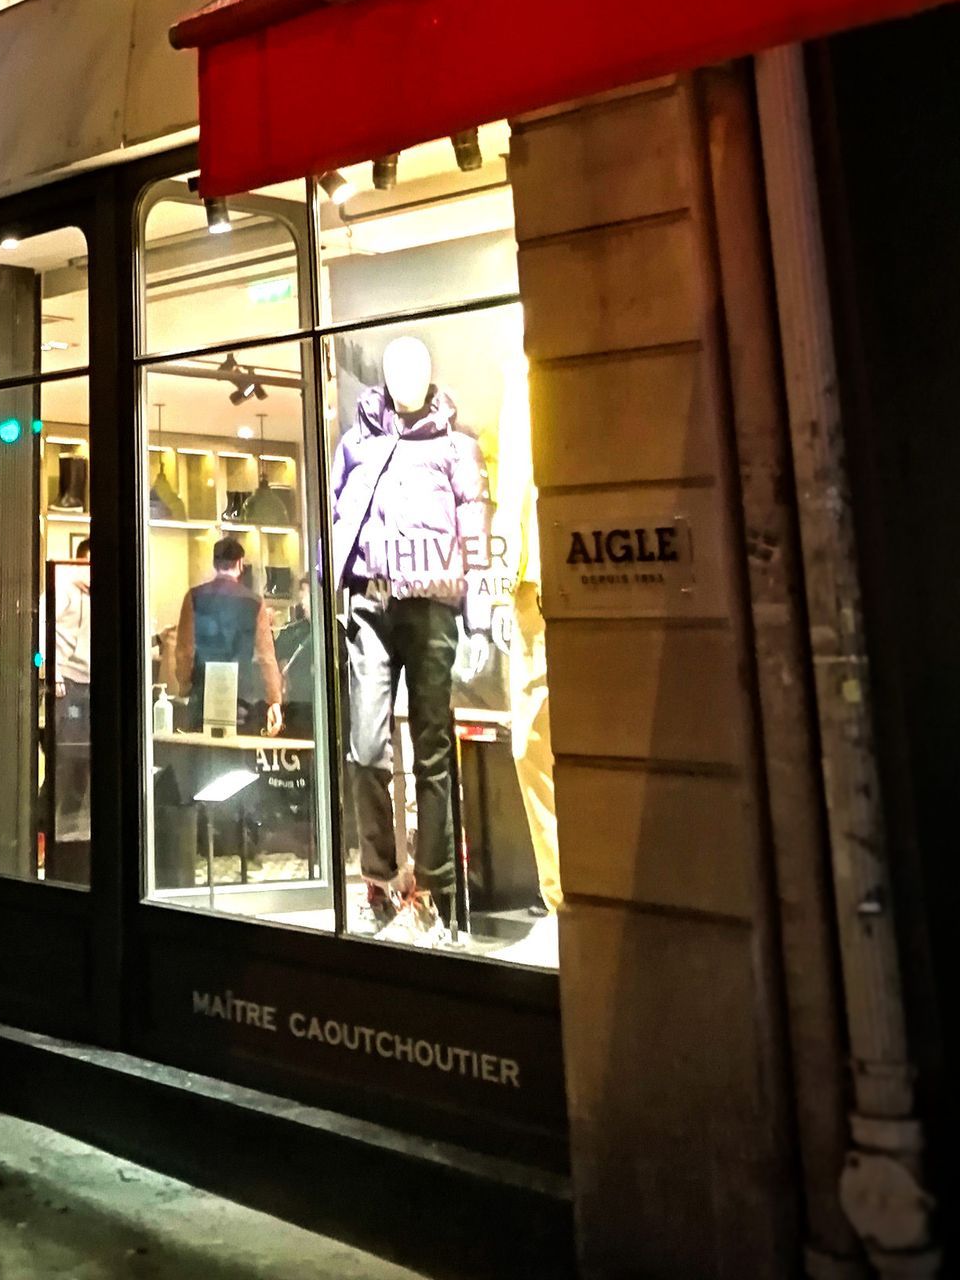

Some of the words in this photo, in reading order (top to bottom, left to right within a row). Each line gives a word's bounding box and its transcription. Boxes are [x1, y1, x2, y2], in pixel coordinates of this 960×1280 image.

[566, 527, 679, 564] AIGLE
[478, 577, 514, 596] AIR
[582, 573, 629, 585] DEPUIS
[289, 1011, 521, 1088] CAOUTCHOUTIER
